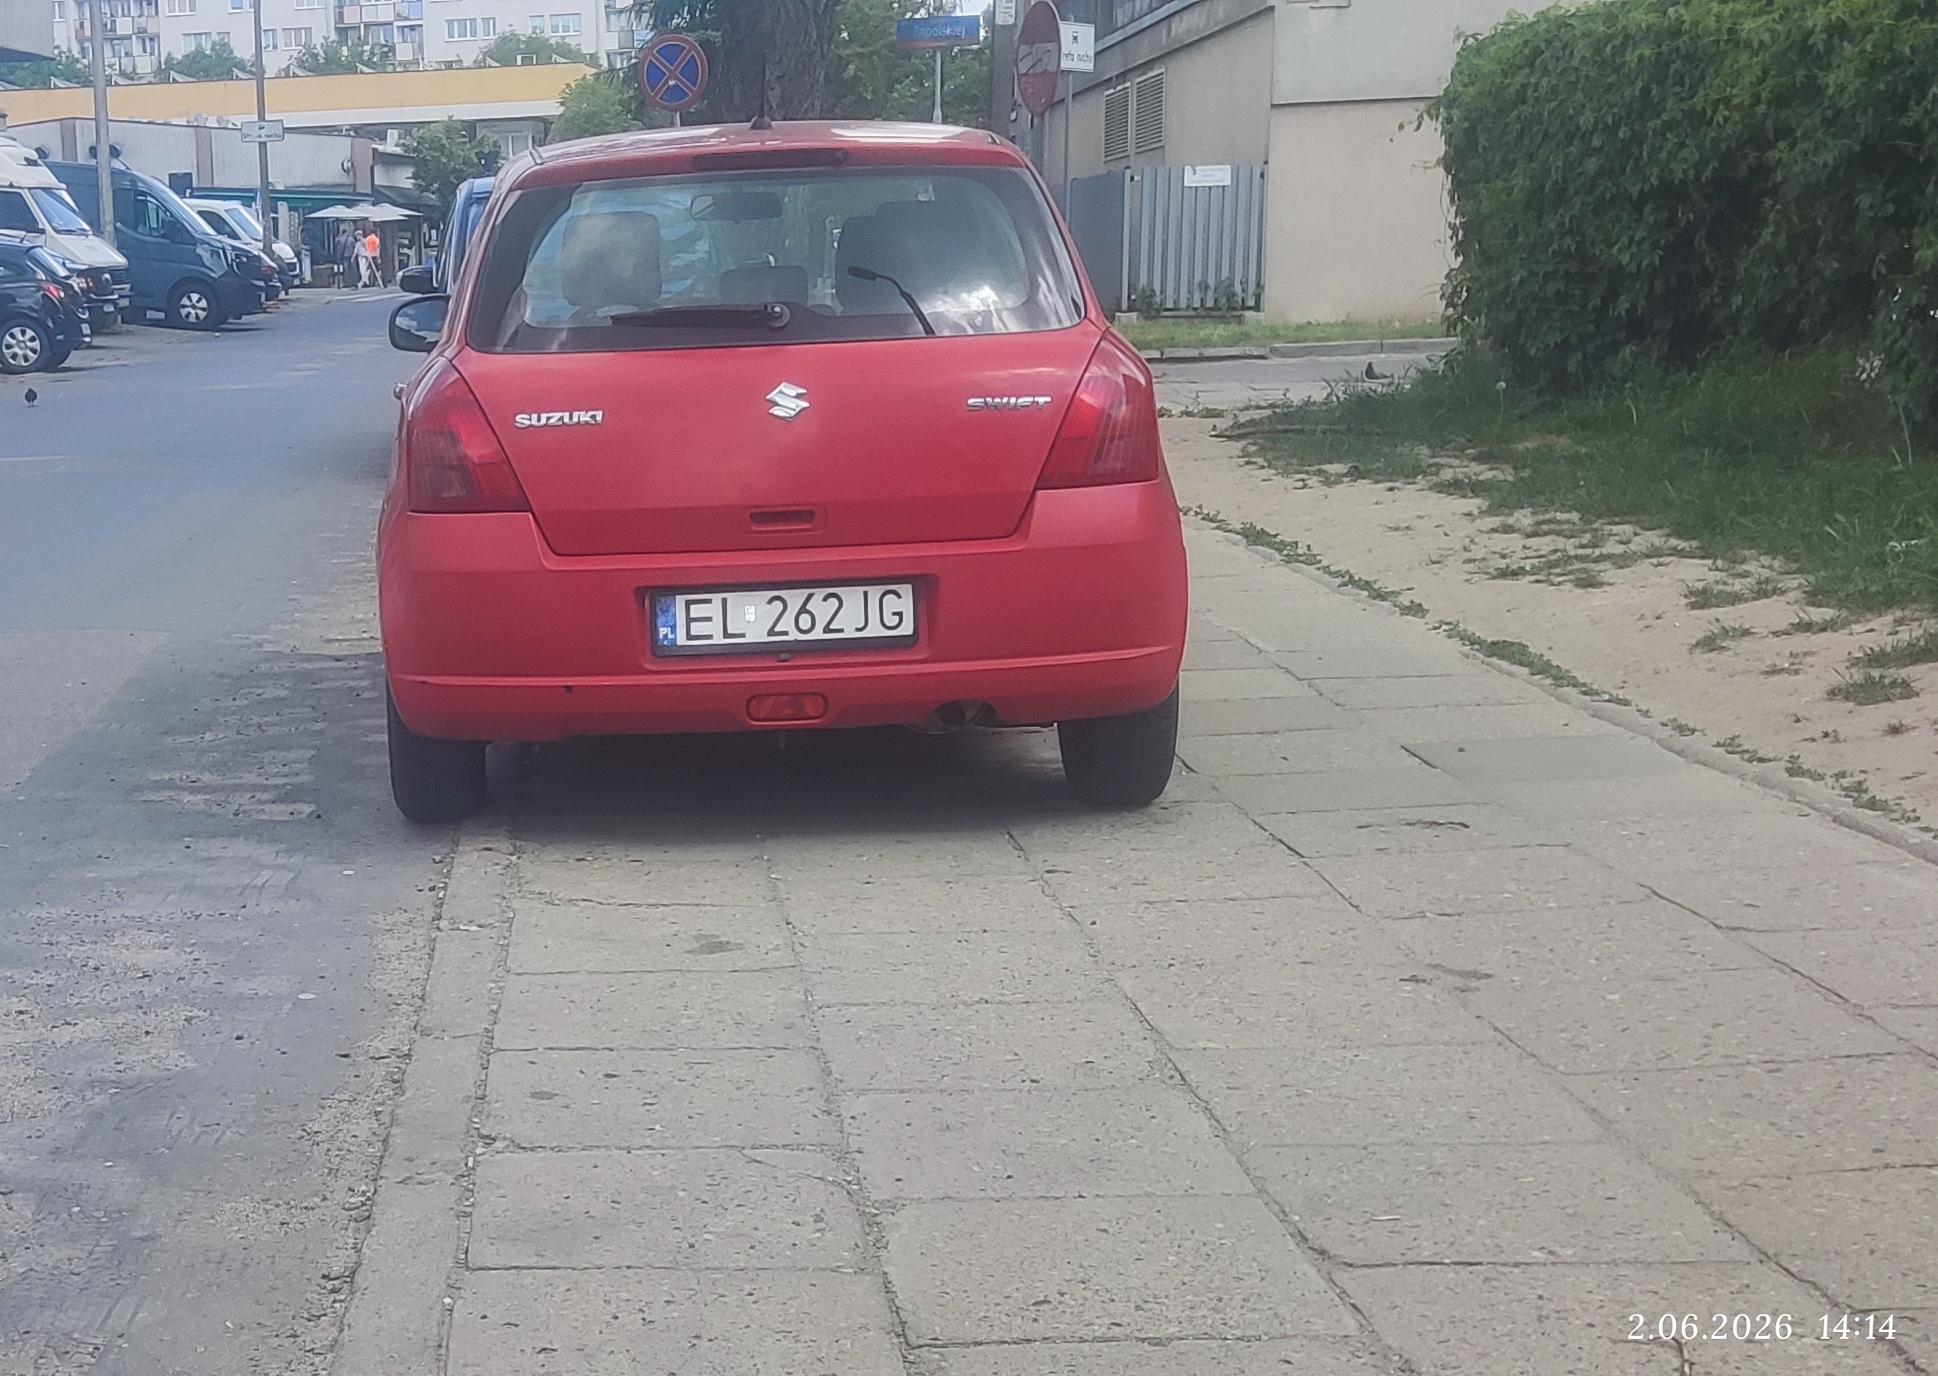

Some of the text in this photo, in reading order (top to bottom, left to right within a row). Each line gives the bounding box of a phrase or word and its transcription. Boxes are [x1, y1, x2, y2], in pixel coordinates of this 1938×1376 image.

[966, 396, 1052, 412] SWIFT
[514, 409, 603, 429] SUZUKI
[684, 589, 904, 641] EL 262JG
[659, 627, 675, 639] PL
